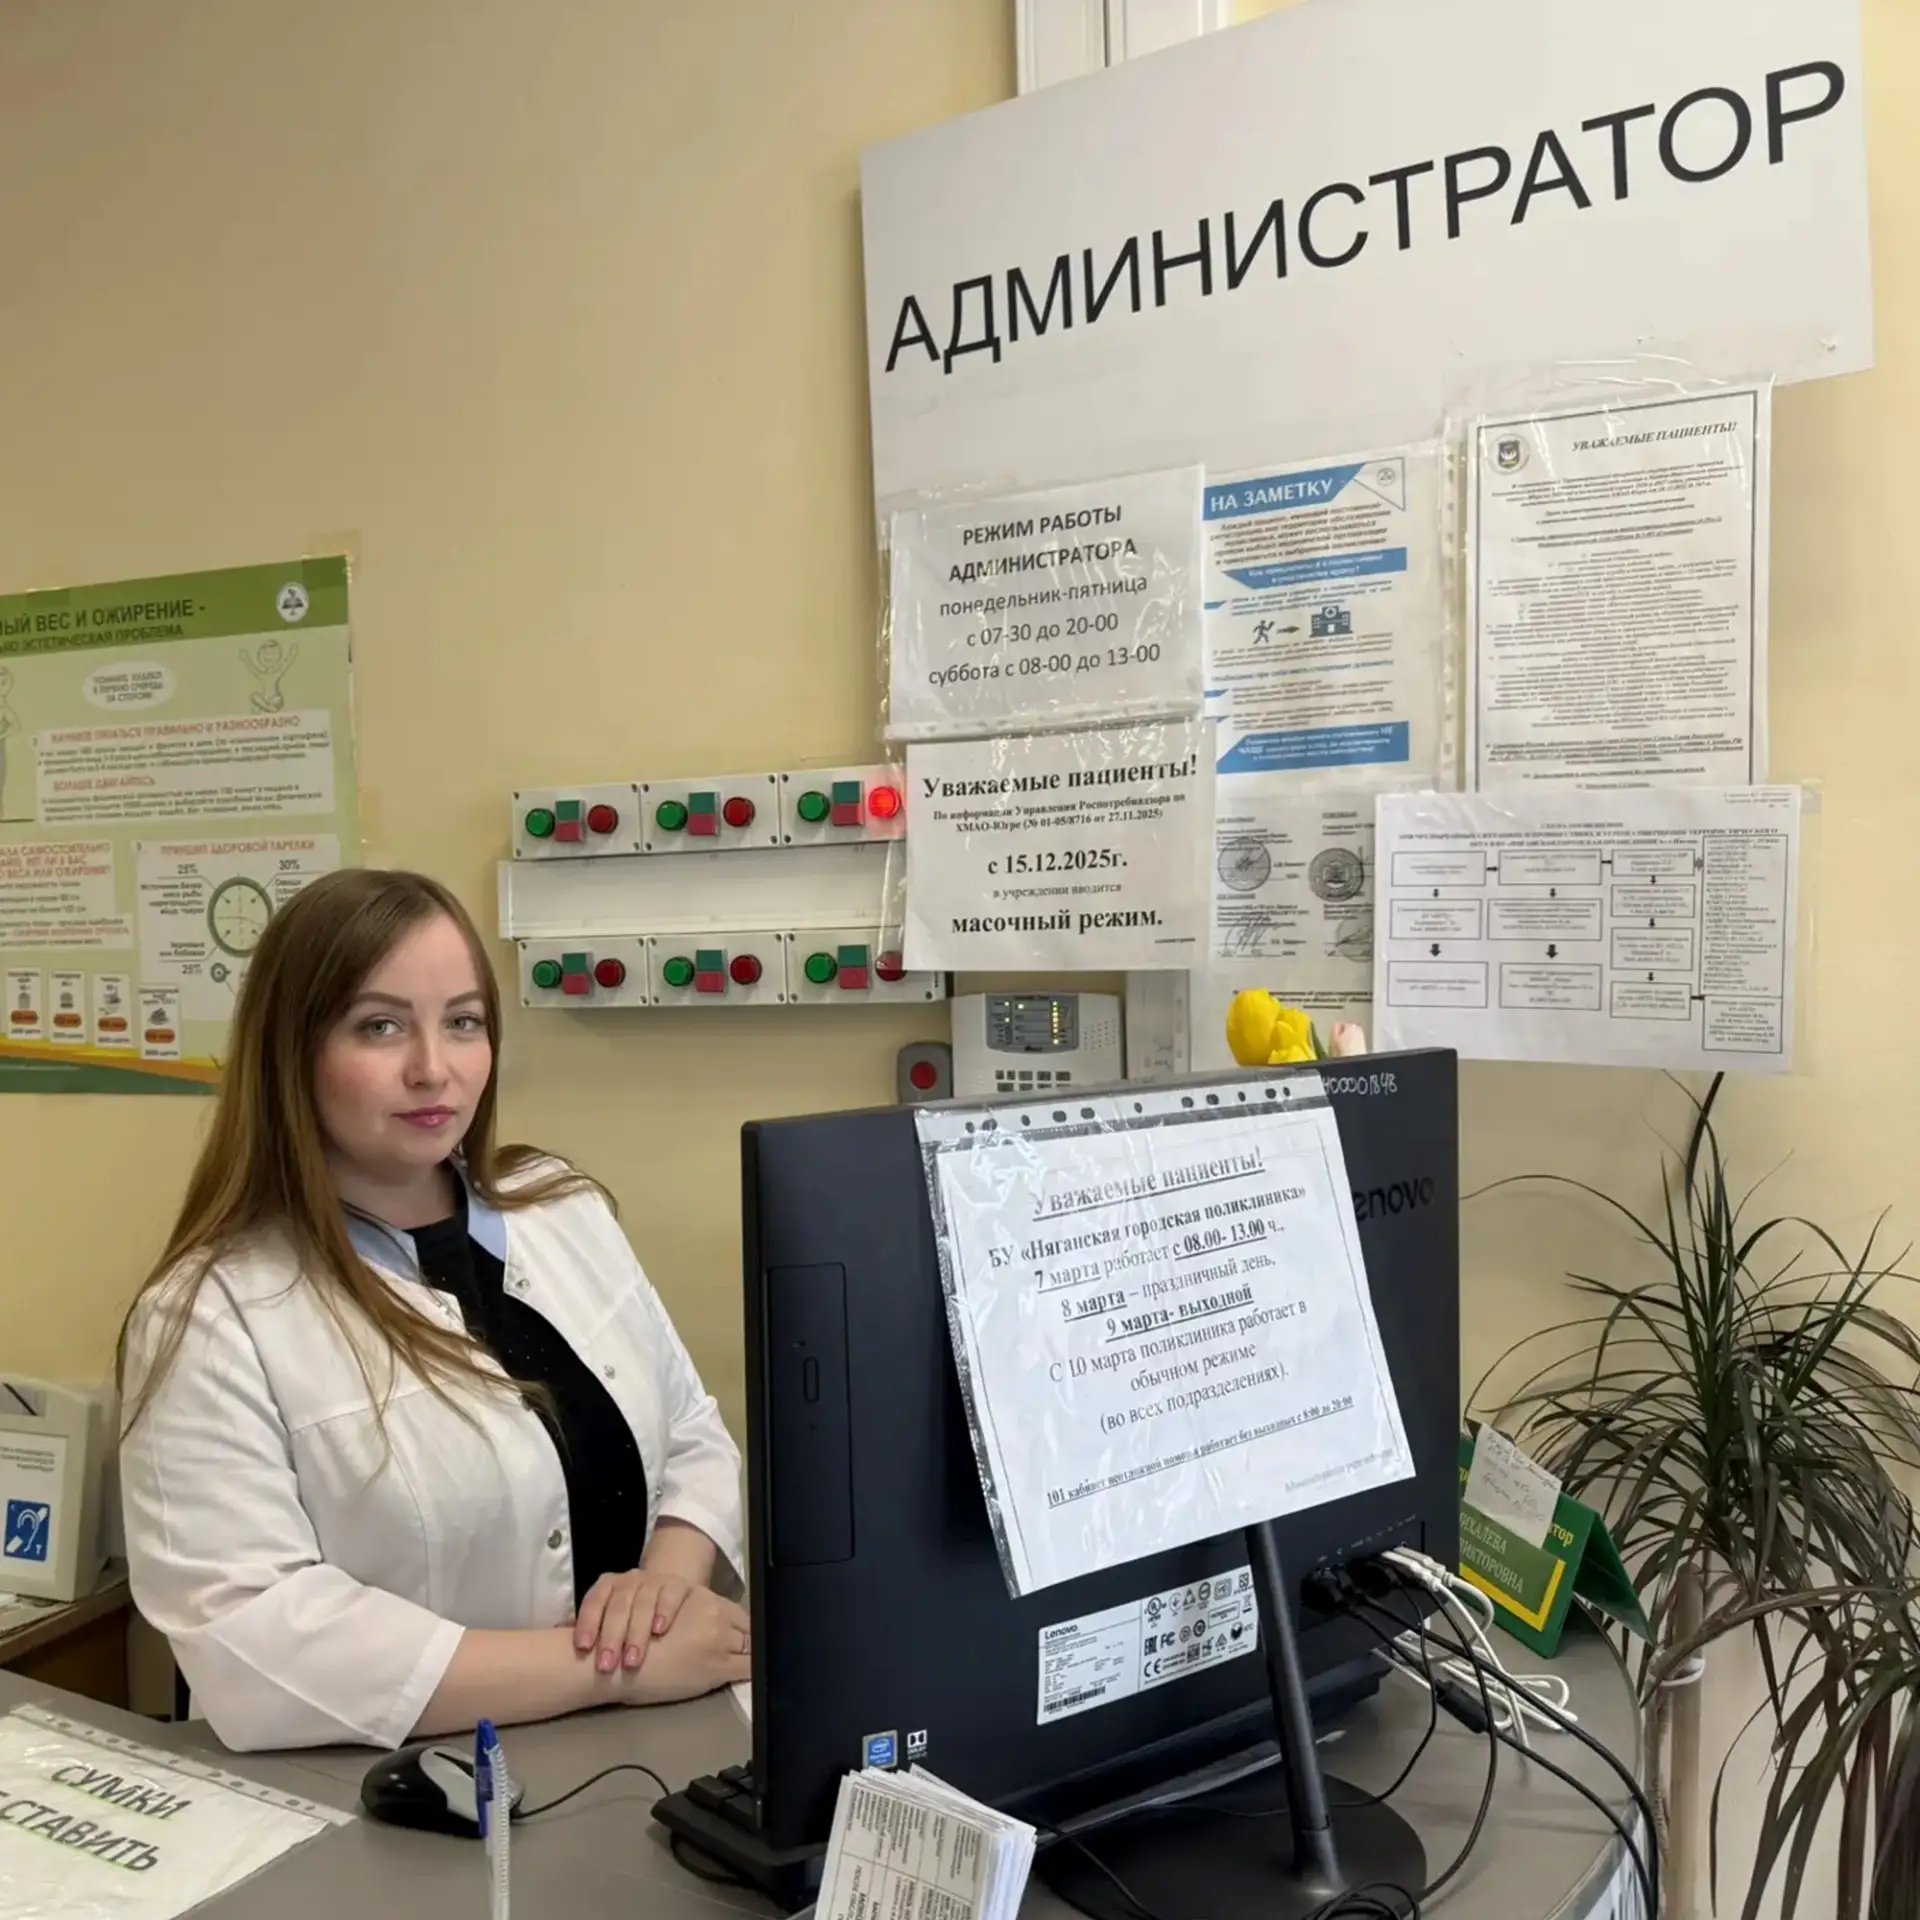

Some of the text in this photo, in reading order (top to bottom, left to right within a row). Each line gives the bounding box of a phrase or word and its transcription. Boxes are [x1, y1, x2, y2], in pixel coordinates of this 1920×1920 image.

[884, 60, 1845, 374] АДМИНИСТРАТОР
[1211, 478, 1334, 512] НА ЗАМЕТКУ
[963, 505, 1122, 545] РЕЖИМ РАБОТЫ
[949, 538, 1137, 583] АДМИНИСТРАТОРА
[36, 613, 70, 632] ВЕС
[76, 610, 87, 627] И
[92, 599, 193, 626] ОЖИРЕНИЕ
[940, 576, 1147, 616] понедельник-пятница
[967, 613, 1118, 647] с 07-30 до 20-00
[929, 644, 1160, 688] суббота с 08-00 до 13-00
[922, 754, 1197, 798] Уважаемые пациенты!
[933, 809, 948, 821] По
[988, 848, 1128, 874] с 15.12.2025г.
[1002, 885, 1069, 901] учреждении
[1072, 882, 1121, 896] вводится
[951, 909, 1163, 935] масочный режим.
[1030, 1145, 1264, 1215] Уважаемые пациенты!
[1353, 1176, 1434, 1222] enovo
[989, 1186, 1306, 1267] БУ «Няганская городская поликлиника»
[1034, 1269, 1044, 1289] 7
[1050, 1261, 1100, 1287] марта
[1104, 1245, 1170, 1276] работает
[1173, 1242, 1180, 1256] с
[1183, 1228, 1227, 1254] 08.00-
[1231, 1218, 1265, 1242] 13.00
[1061, 1299, 1072, 1317] 8
[1076, 1289, 1125, 1315] марта
[1143, 1257, 1237, 1300] праздничный
[1106, 1283, 1253, 1337] 9 марта- выходной
[1049, 1300, 1307, 1382] С 10 марта поликлиника работает в
[1130, 1343, 1256, 1392] обычном режиме
[1100, 1363, 1290, 1435] (во всех подразделениях).
[1046, 1489, 1065, 1506] 101
[1459, 1537, 1524, 1594] ИКТОРОВНА
[1044, 1624, 1078, 1640] Lenovo
[51, 1765, 193, 1819] СУМКИ
[0, 1800, 159, 1872] СТАВИТЬ
